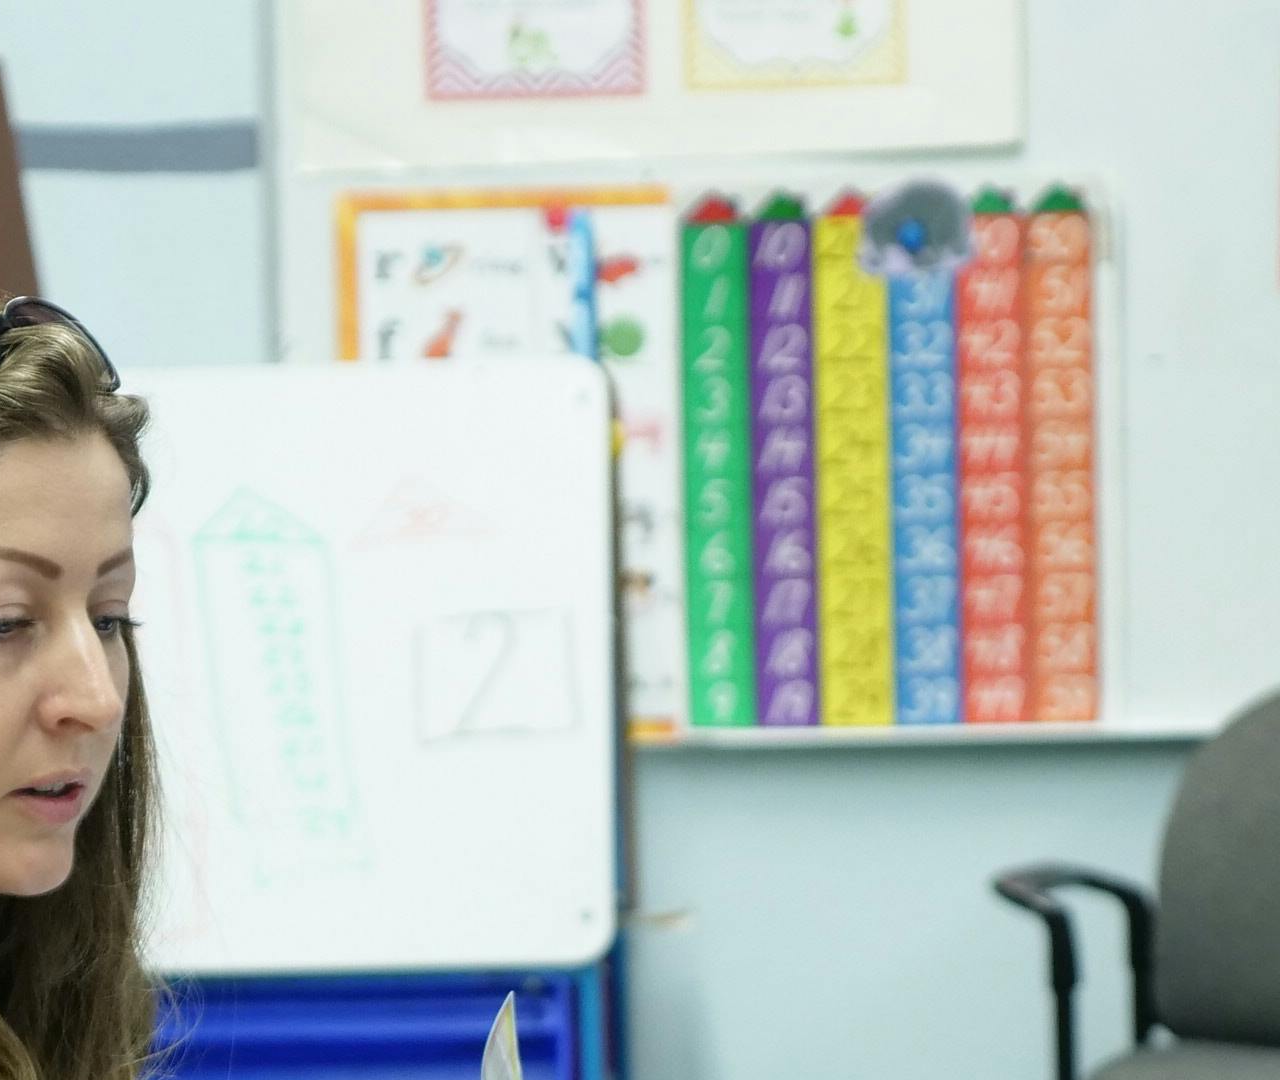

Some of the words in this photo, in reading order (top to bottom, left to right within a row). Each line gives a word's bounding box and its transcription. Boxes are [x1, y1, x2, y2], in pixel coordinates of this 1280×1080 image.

[691, 224, 731, 271] 0
[704, 273, 729, 319] 1
[694, 325, 732, 372] 2
[758, 323, 808, 371] 12
[896, 320, 954, 368] 32
[961, 318, 1020, 364] 42
[1033, 317, 1090, 364] 52
[694, 376, 732, 423] 3
[896, 371, 955, 418] 33
[963, 369, 1020, 417] 43
[1033, 367, 1090, 415] 53
[699, 478, 732, 527] 5
[898, 474, 955, 521] 35
[964, 472, 1020, 518] 45
[1035, 471, 1091, 518] 55
[700, 530, 737, 577] 6
[763, 528, 812, 575] 16
[899, 525, 956, 572] 36
[704, 578, 734, 626] 7
